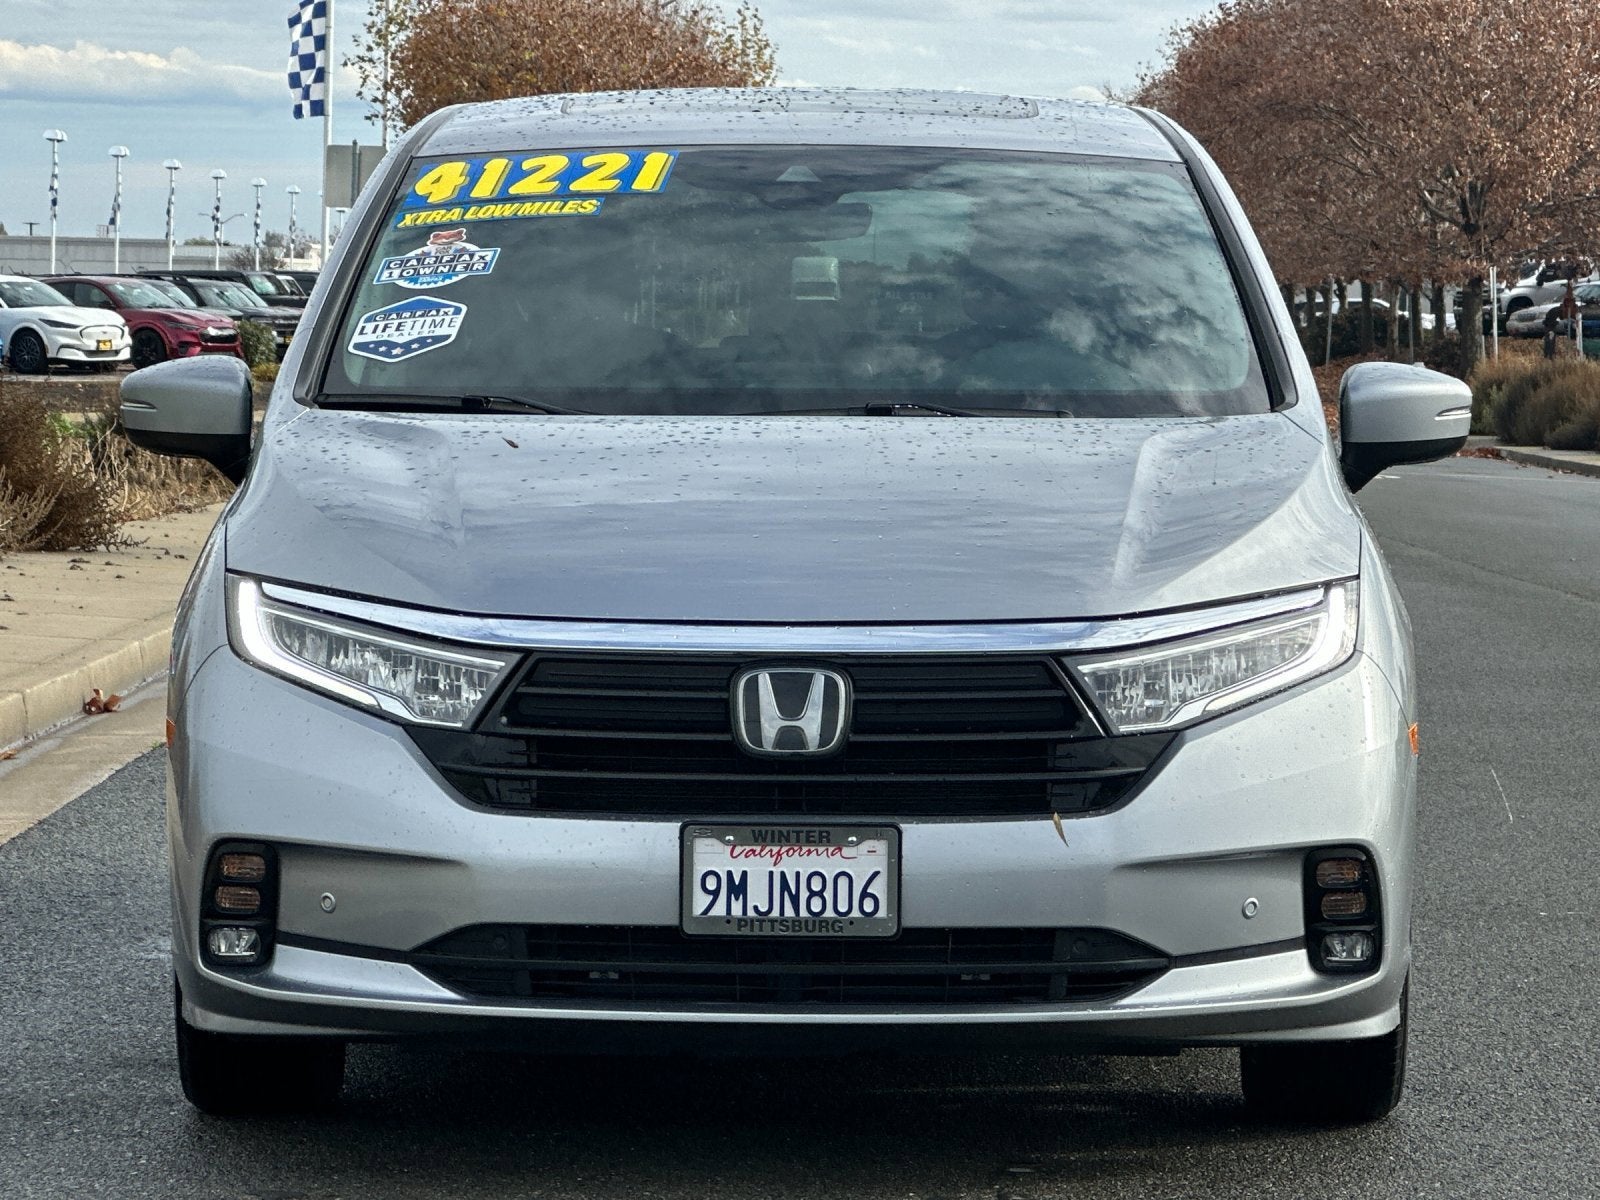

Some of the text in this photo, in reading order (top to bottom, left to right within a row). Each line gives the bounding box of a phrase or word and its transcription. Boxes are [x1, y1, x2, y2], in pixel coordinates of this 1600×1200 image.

[414, 152, 673, 204] 41221
[397, 208, 464, 228] XTRA
[389, 253, 489, 269] CARFAX
[375, 309, 452, 321] CARFAX
[358, 317, 460, 336] LIFETIME
[376, 329, 436, 340] DEALER
[752, 829, 831, 844] WINTER
[700, 869, 881, 918] 9MJN806
[736, 918, 844, 934] PITTSBURG
